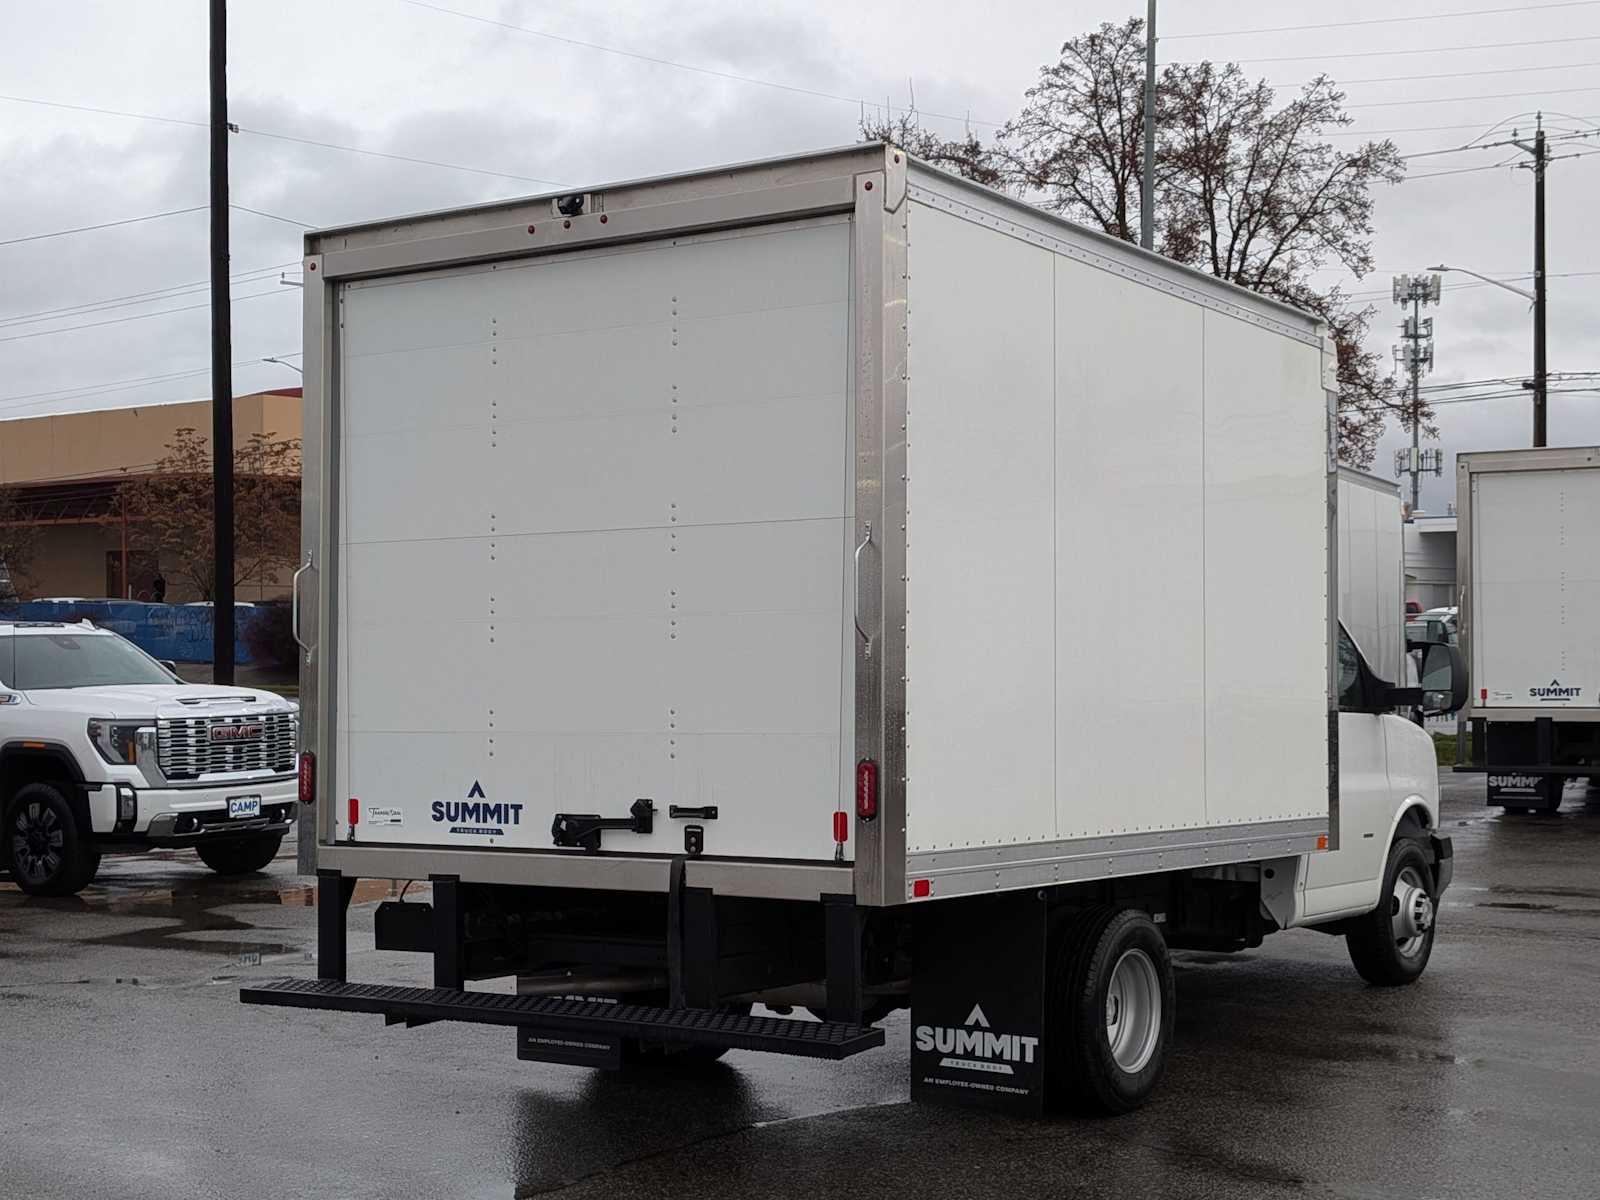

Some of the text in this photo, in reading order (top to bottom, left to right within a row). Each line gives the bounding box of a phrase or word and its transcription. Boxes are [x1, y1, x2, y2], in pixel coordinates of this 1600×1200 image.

[1529, 687, 1582, 697] SUMMIT
[212, 724, 263, 740] GMC
[230, 800, 258, 815] CAMP
[431, 800, 523, 825] SUMMIT
[915, 1025, 1039, 1063] SUMMIT
[923, 1076, 934, 1084] AN
[995, 1085, 1030, 1095] COMPANY
